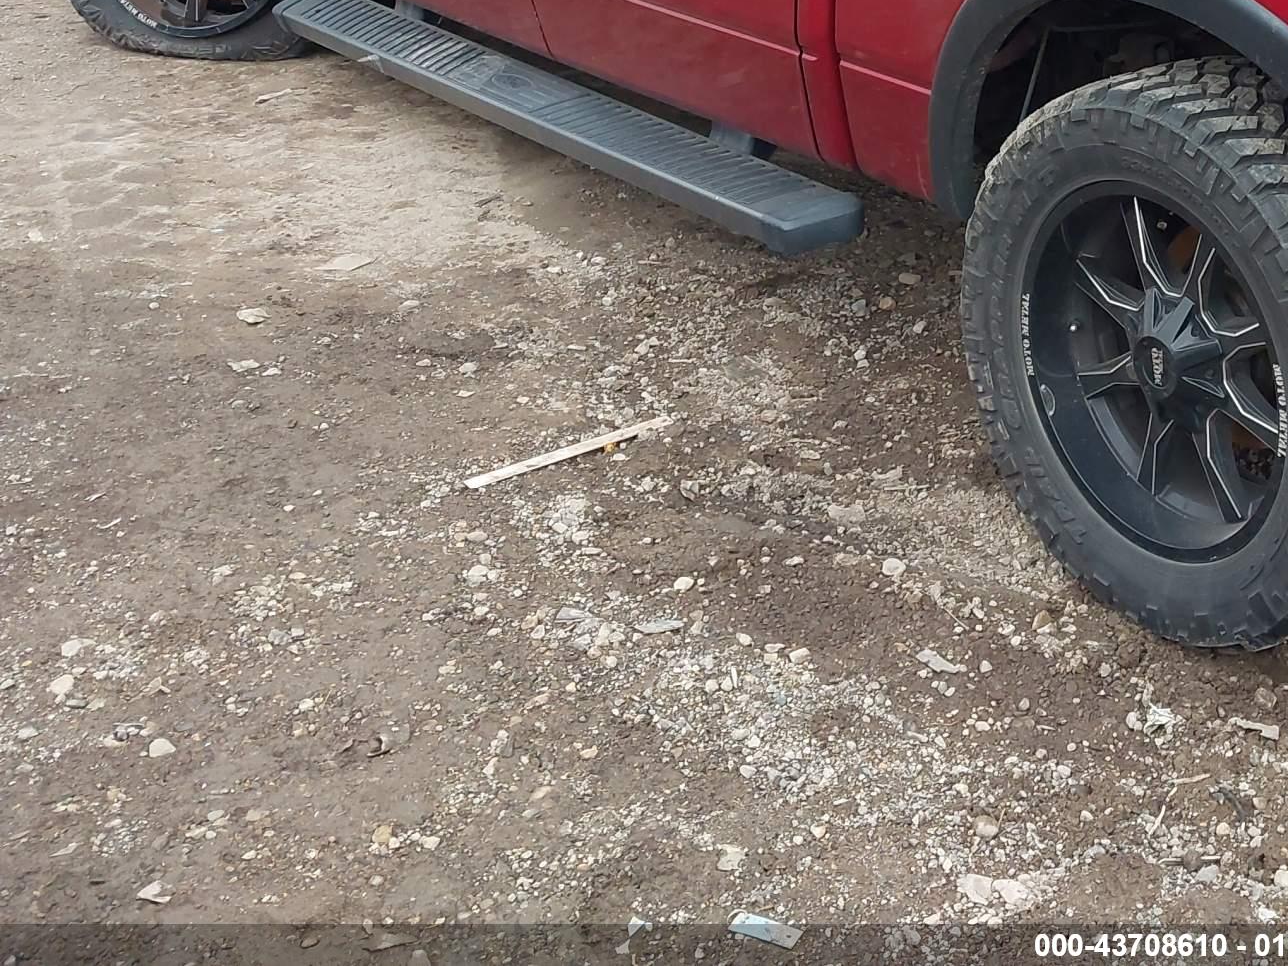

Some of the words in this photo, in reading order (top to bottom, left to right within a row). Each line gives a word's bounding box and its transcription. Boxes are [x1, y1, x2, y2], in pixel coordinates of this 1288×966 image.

[1021, 293, 1030, 337] METAL
[1023, 338, 1036, 376] MOTO
[1272, 363, 1287, 407] MOTO
[1278, 409, 1288, 458] METAL
